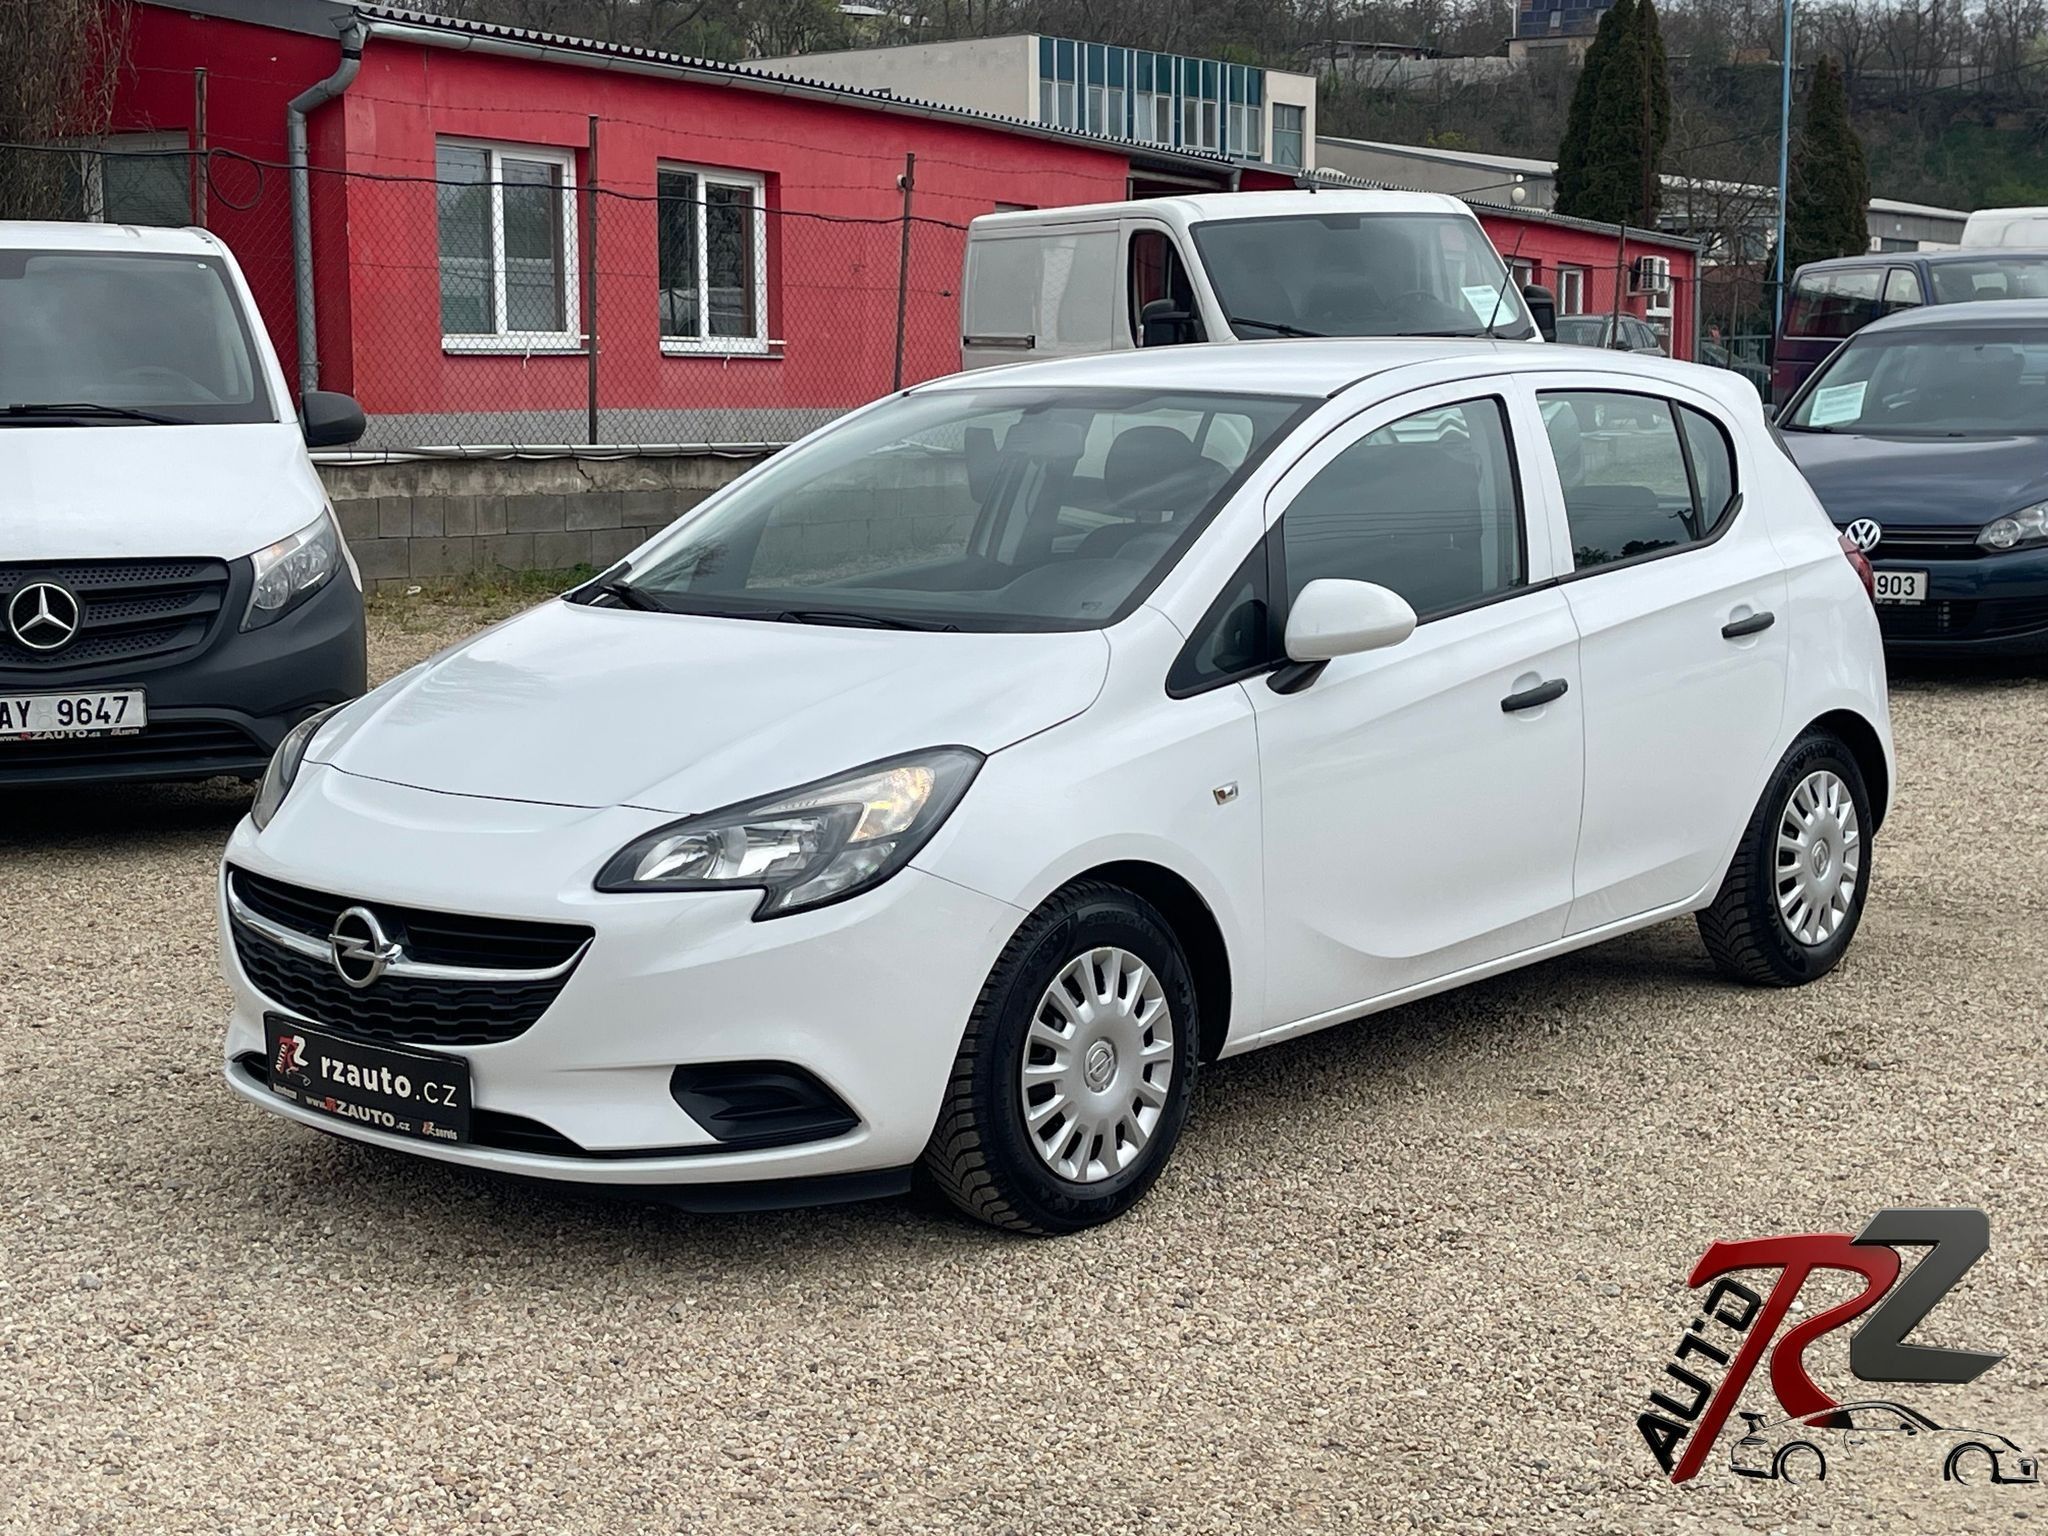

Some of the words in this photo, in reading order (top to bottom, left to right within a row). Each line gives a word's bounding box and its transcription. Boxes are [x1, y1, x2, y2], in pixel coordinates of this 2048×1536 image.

[1877, 575, 1915, 596] 903
[0, 700, 31, 729] AY
[57, 696, 129, 727] 9647
[321, 1055, 458, 1108] rzauto.cz
